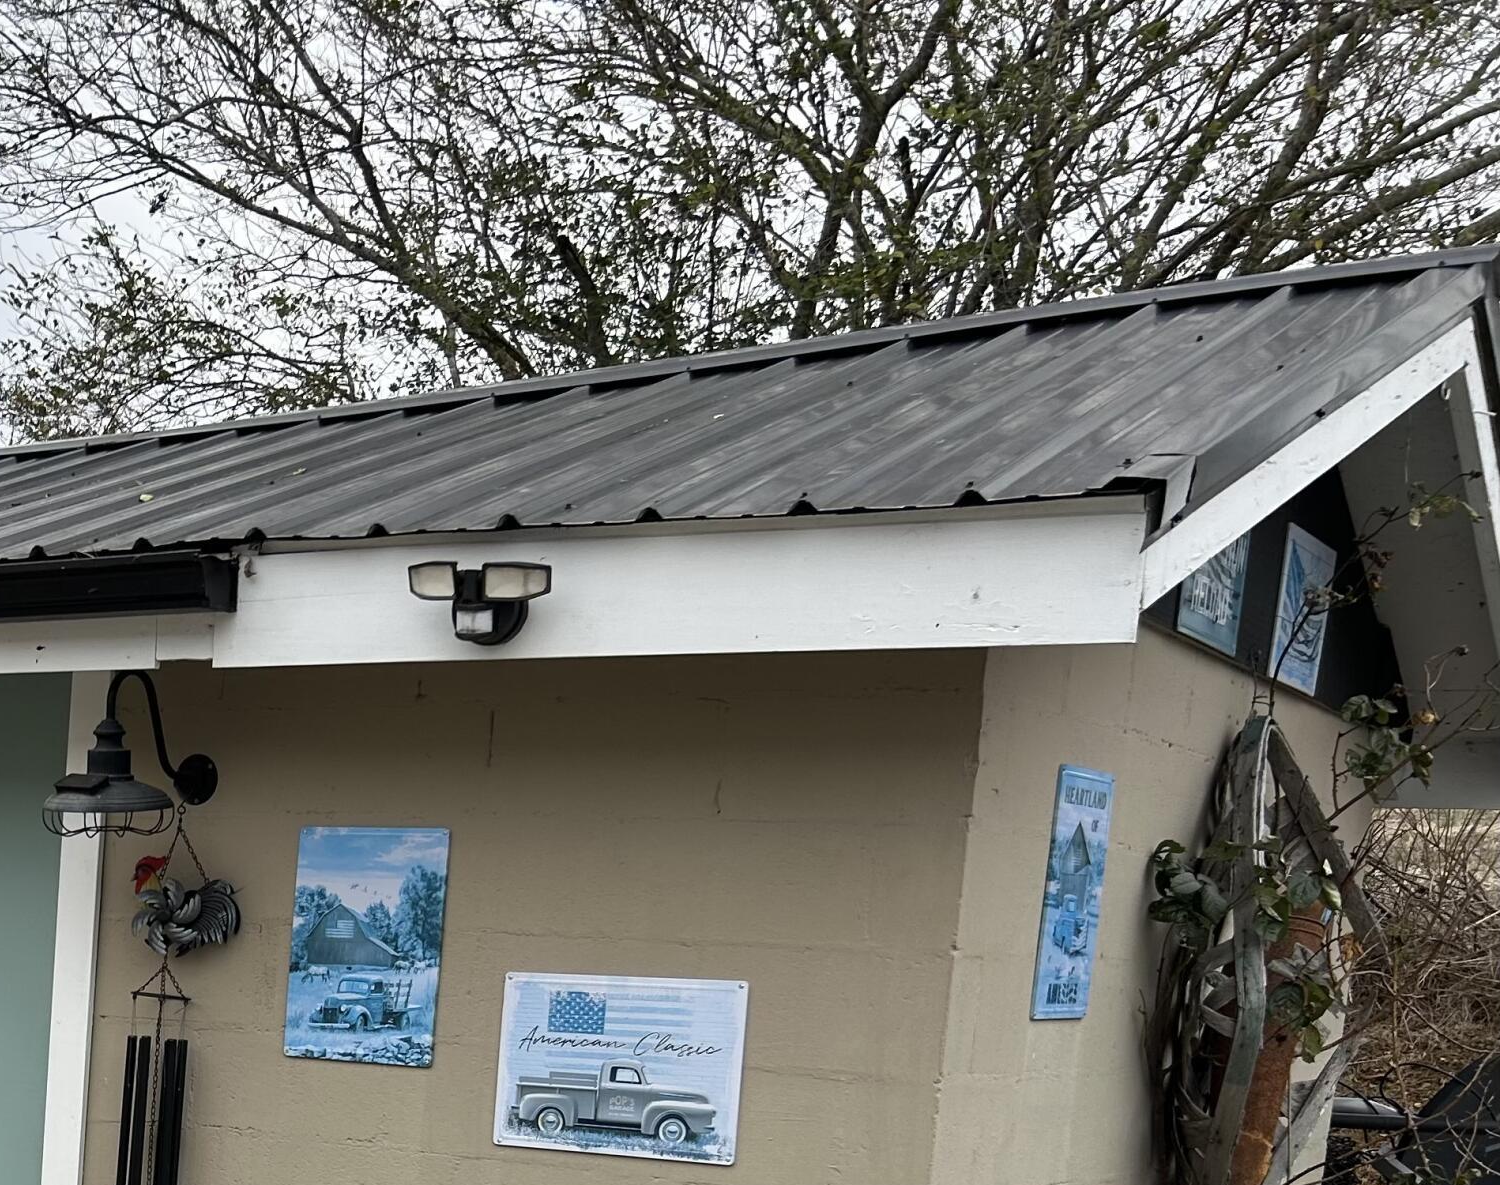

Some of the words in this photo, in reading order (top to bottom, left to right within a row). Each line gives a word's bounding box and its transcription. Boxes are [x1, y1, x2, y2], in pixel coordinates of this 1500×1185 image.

[1064, 784, 1108, 810] HEARTLAND
[518, 1025, 627, 1052] American
[633, 1032, 723, 1057] Classic
